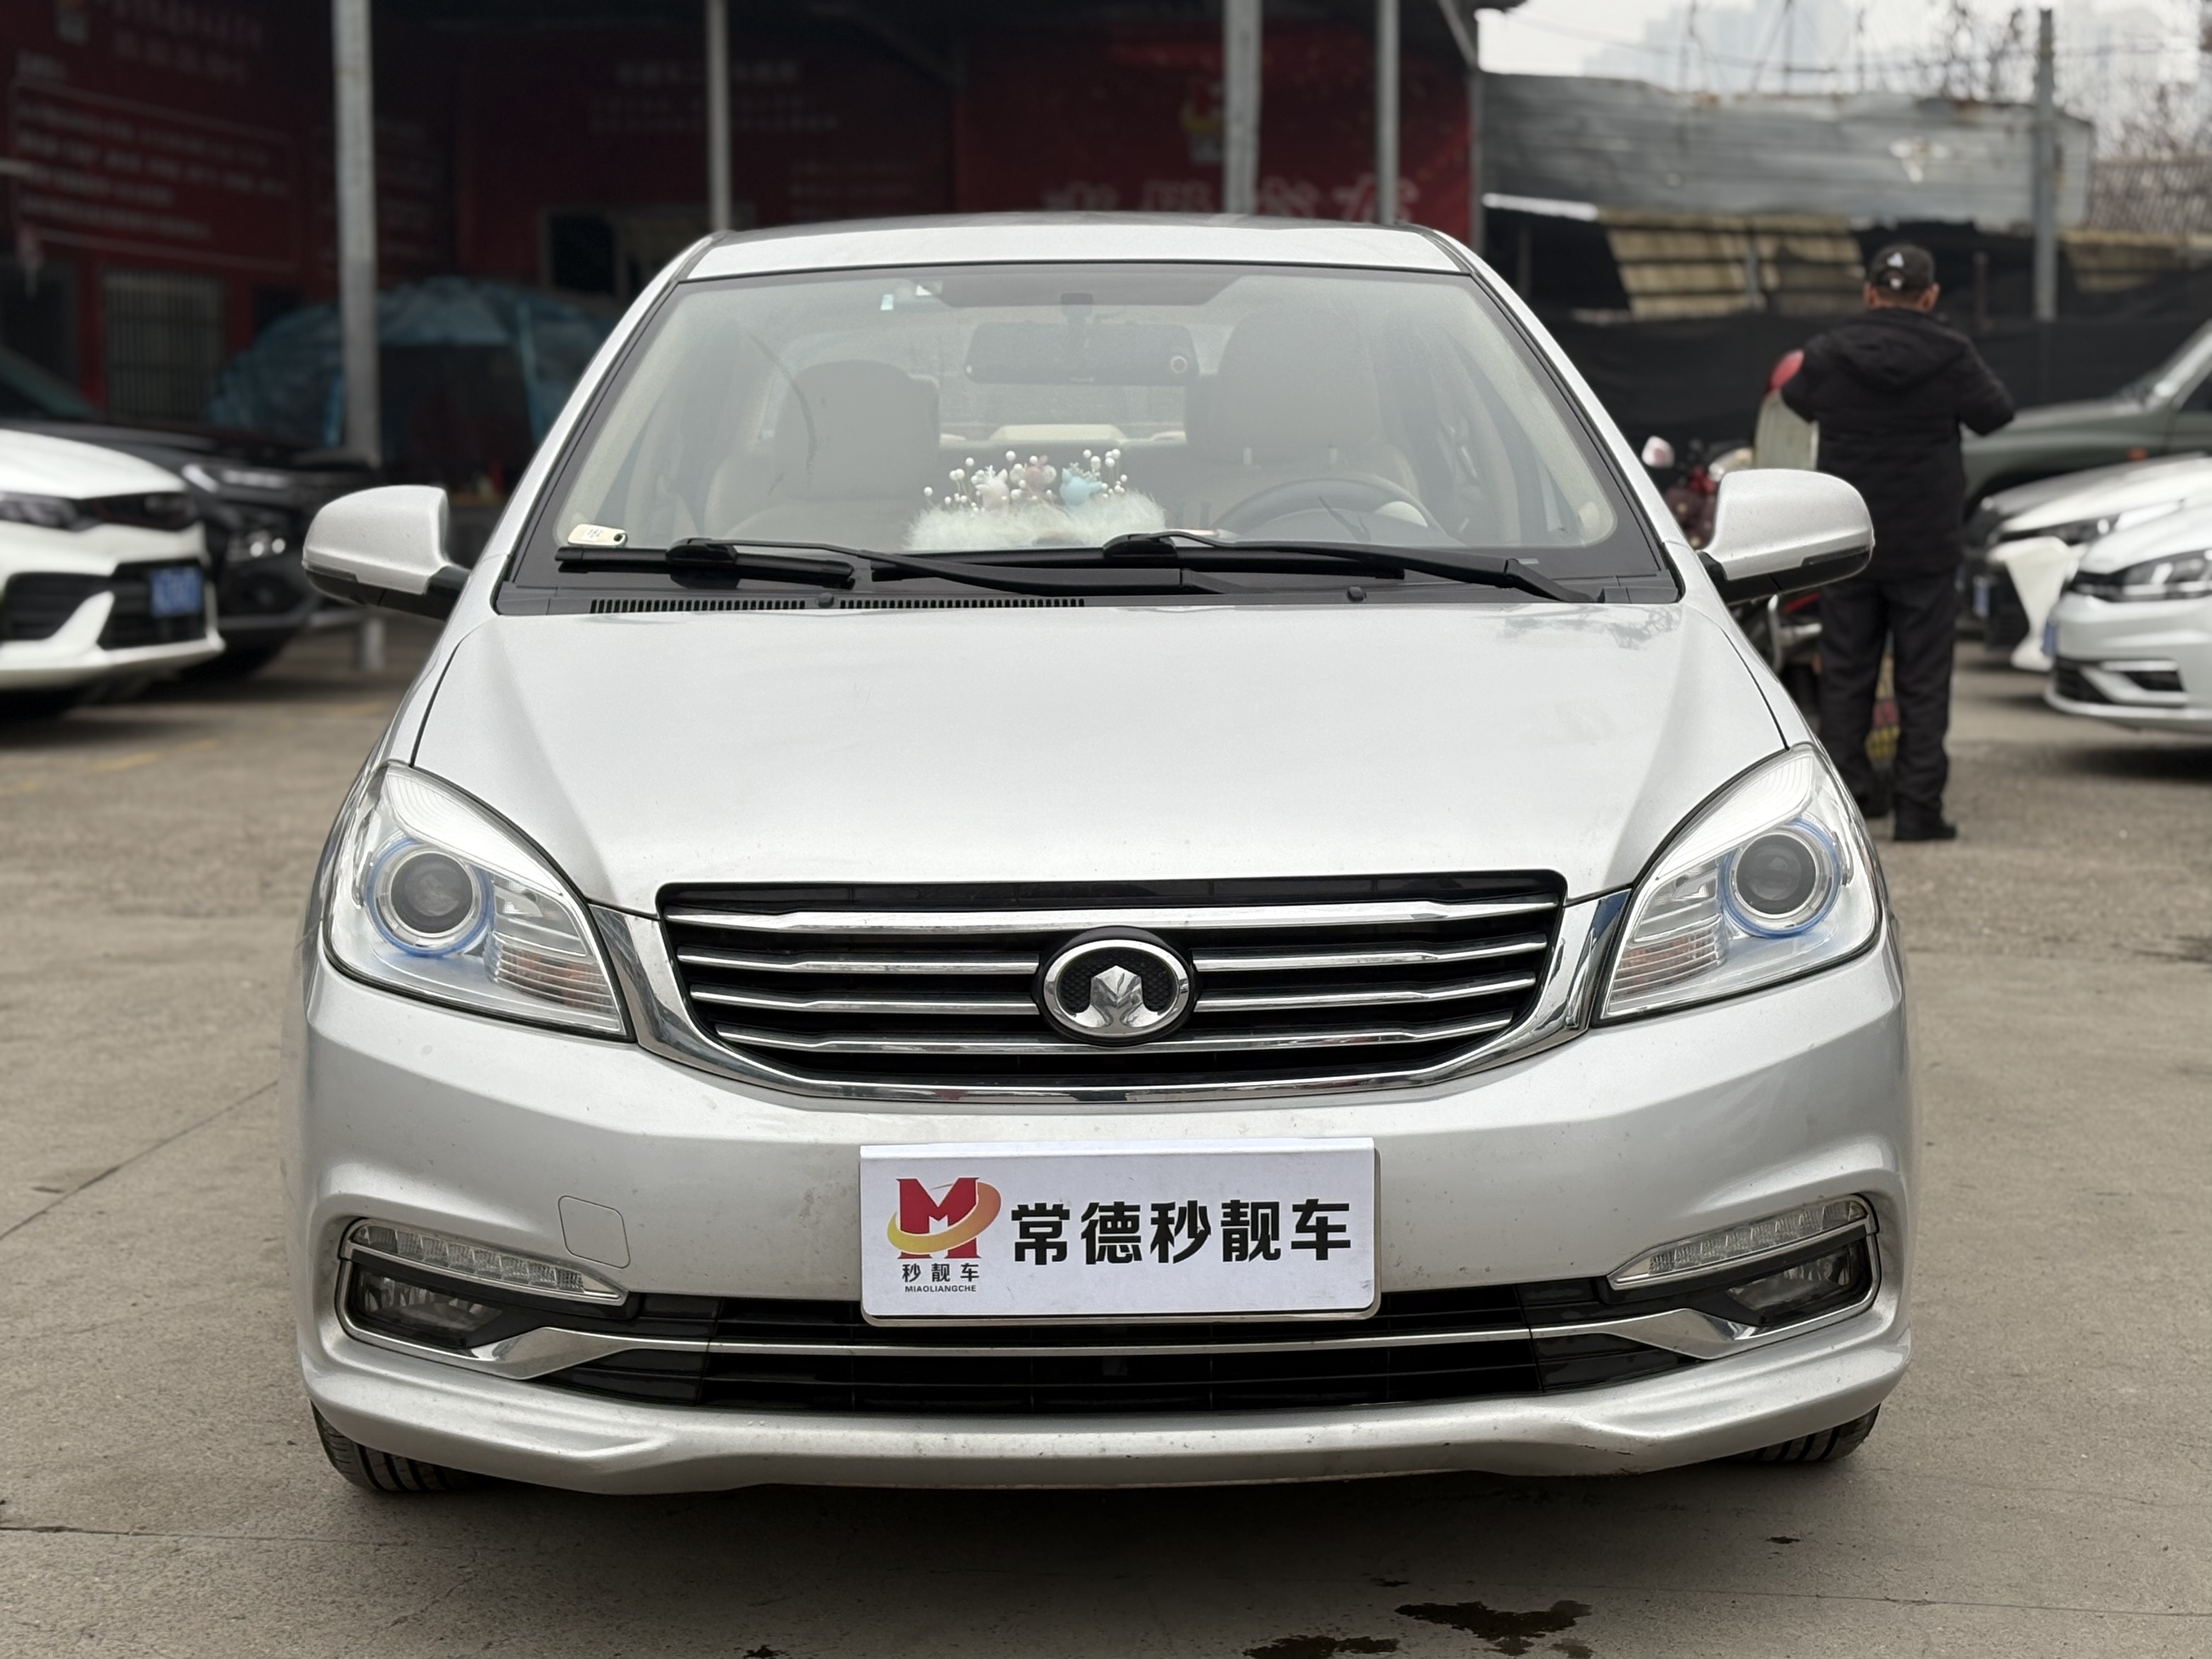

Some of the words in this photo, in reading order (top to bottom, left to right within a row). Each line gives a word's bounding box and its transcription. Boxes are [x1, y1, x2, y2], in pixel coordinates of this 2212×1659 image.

[1011, 1198, 1351, 1266] 常德秒靓车
[901, 1262, 980, 1283] 秒靓车
